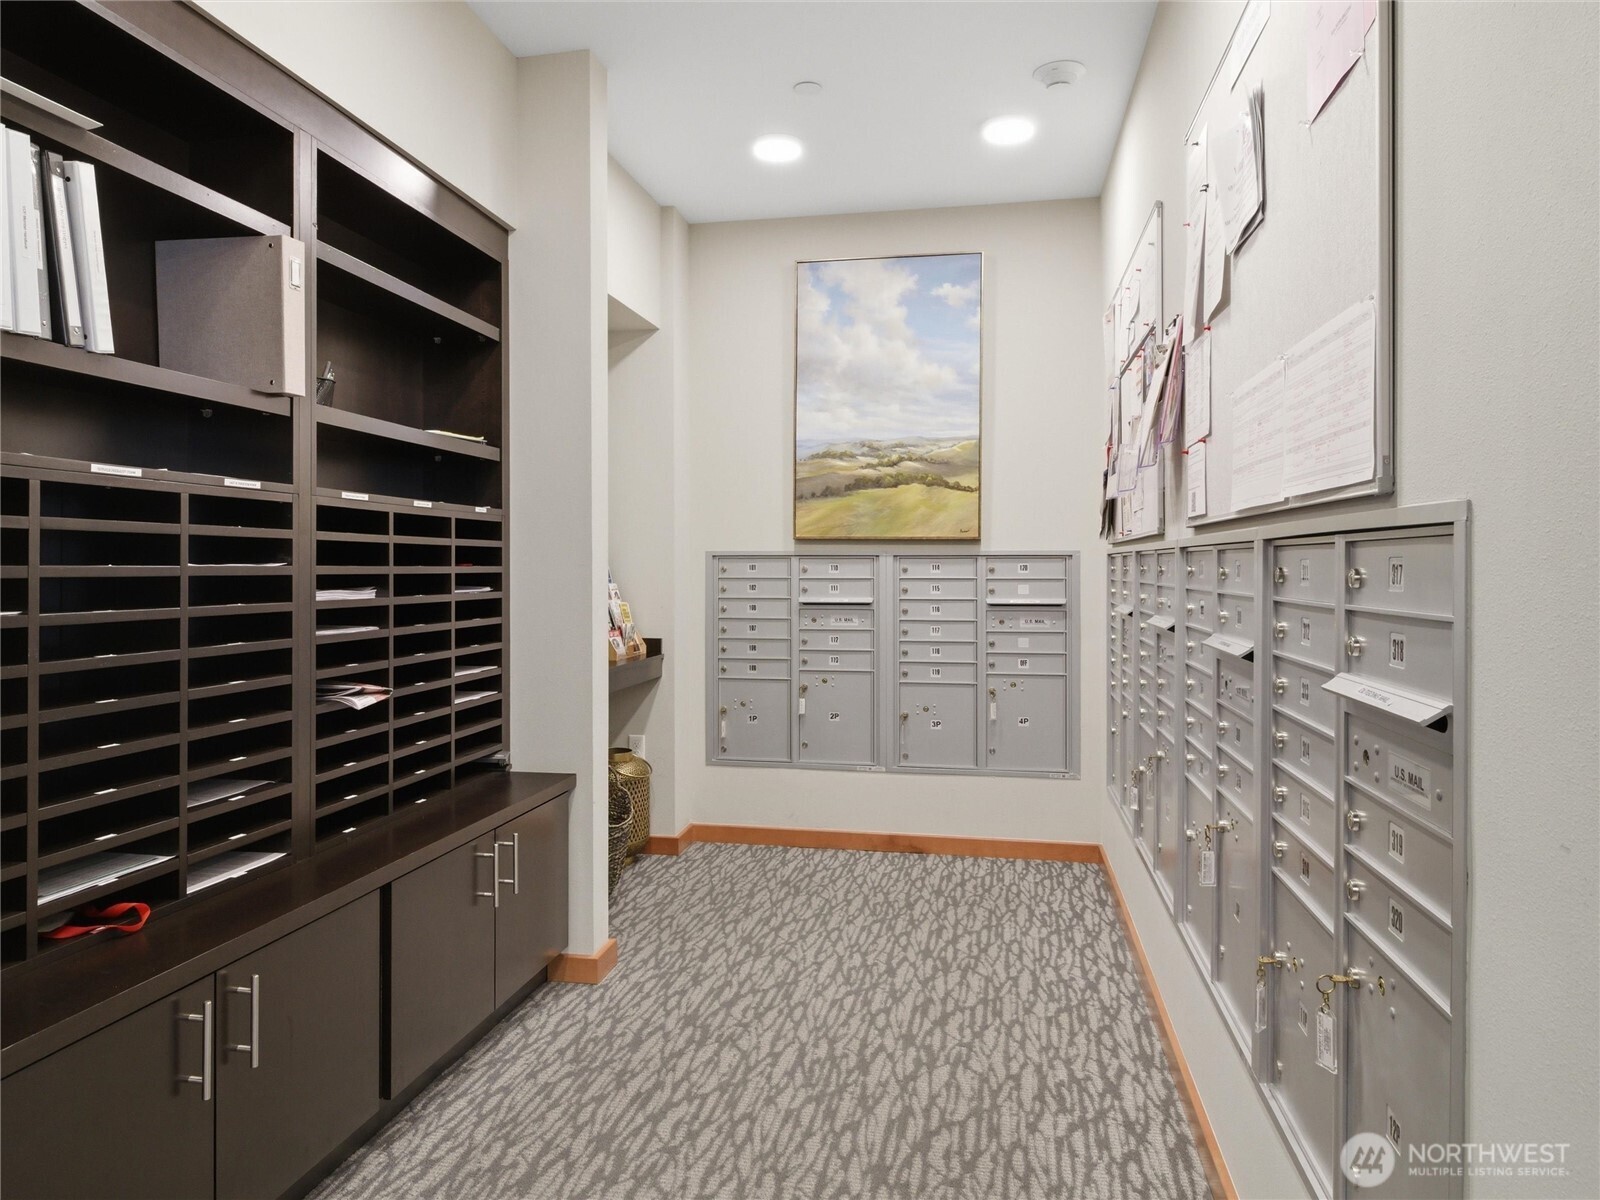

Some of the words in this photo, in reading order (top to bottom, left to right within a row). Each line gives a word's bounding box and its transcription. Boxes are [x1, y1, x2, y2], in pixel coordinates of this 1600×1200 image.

[1391, 563, 1403, 586] 317
[1392, 638, 1405, 663] 318
[1019, 659, 1028, 667] OFF
[931, 720, 941, 728] 3P
[1018, 717, 1029, 725] 4P
[1394, 764, 1407, 781] U.S.
[1408, 771, 1425, 791] MAIL
[1390, 829, 1404, 856] 319
[1391, 904, 1403, 934] 320
